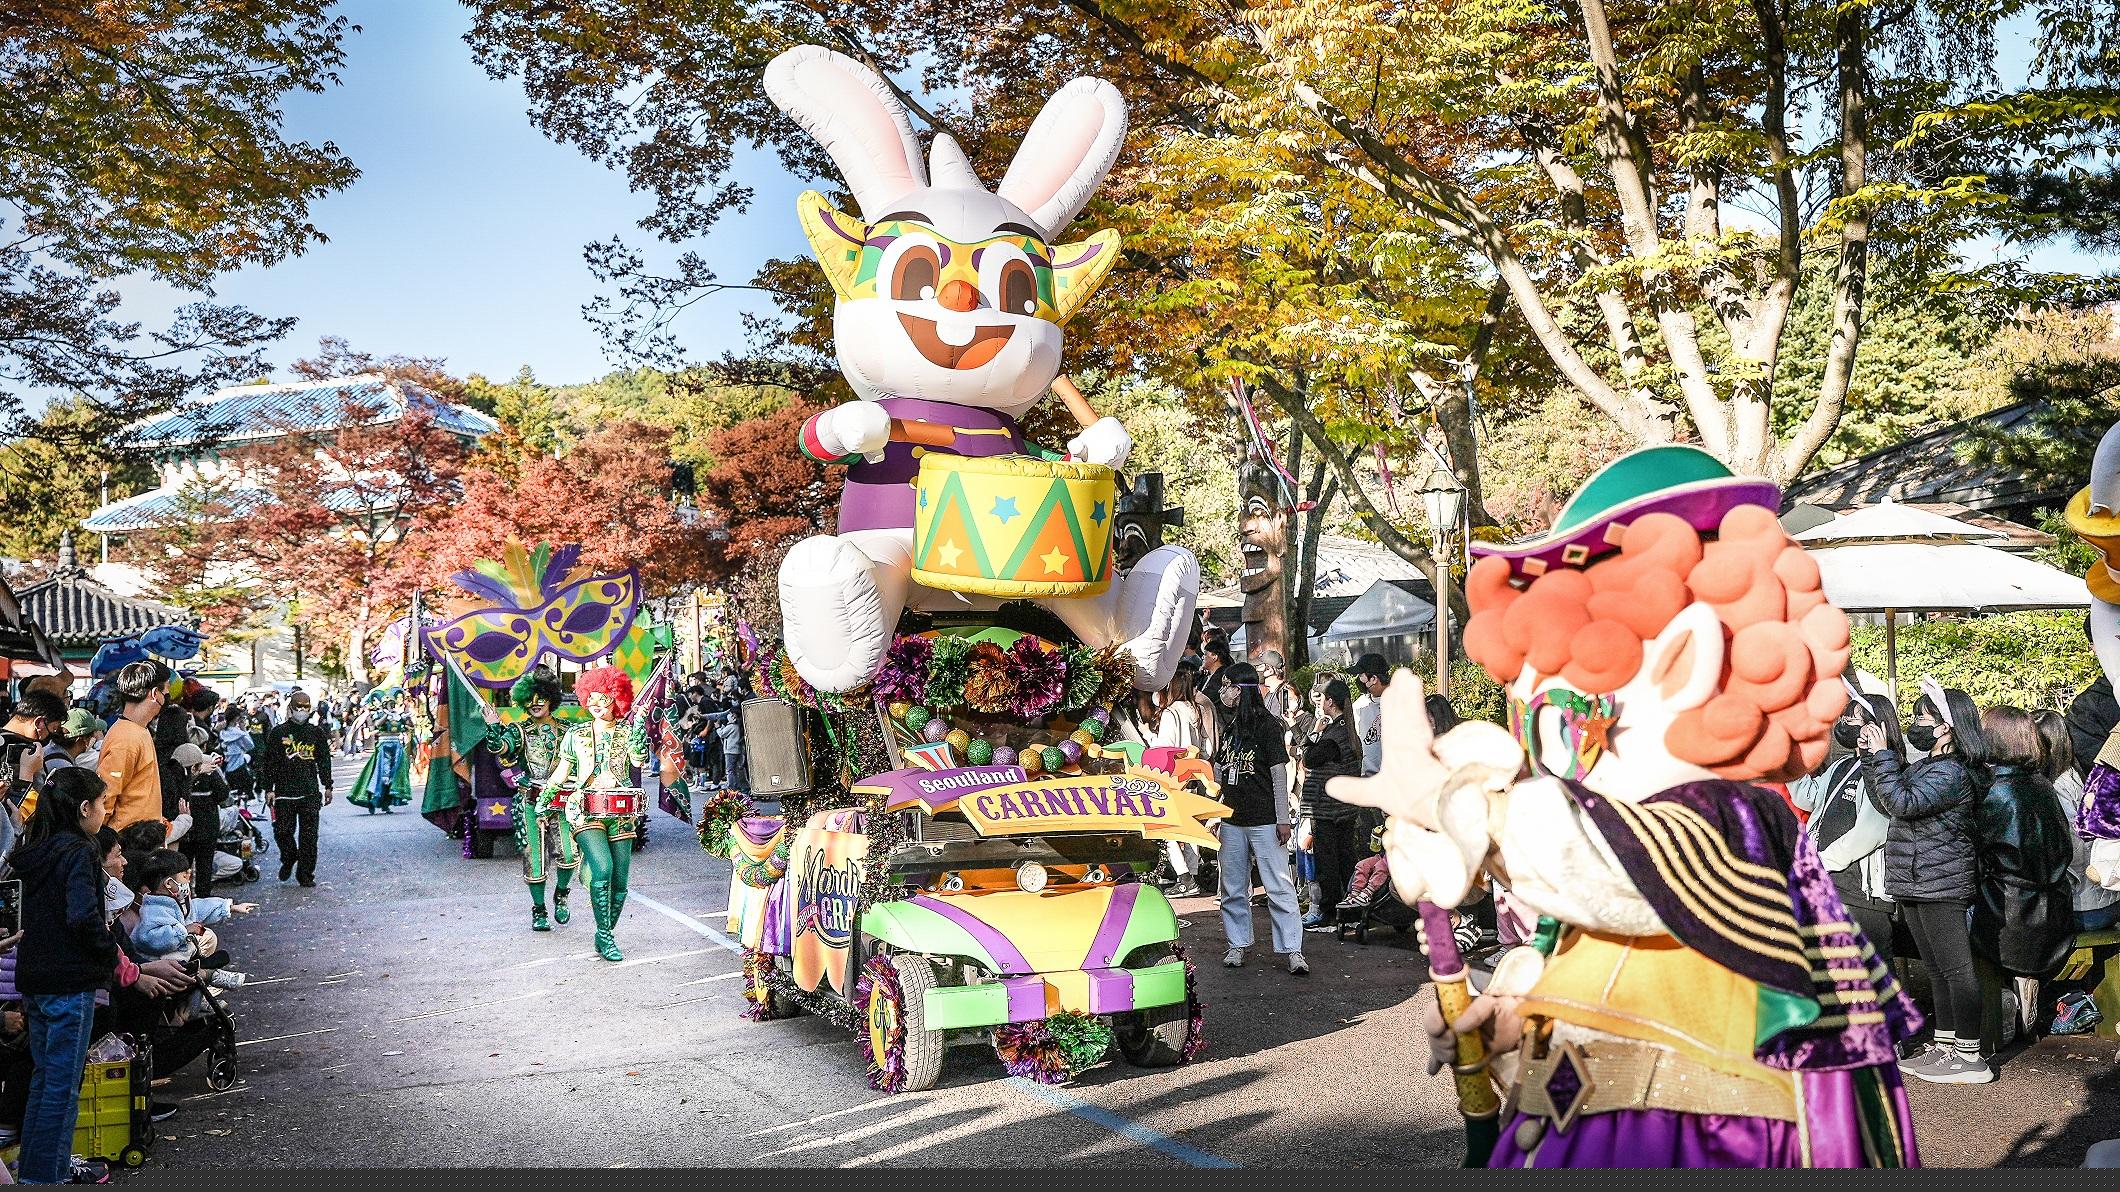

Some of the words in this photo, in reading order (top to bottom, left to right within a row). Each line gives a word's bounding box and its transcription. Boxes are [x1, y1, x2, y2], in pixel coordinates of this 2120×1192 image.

[918, 767, 1020, 794] Seoulland
[1109, 776, 1168, 801] 2022
[976, 786, 1167, 821] CARNIVAL
[821, 897, 857, 932] GRA
